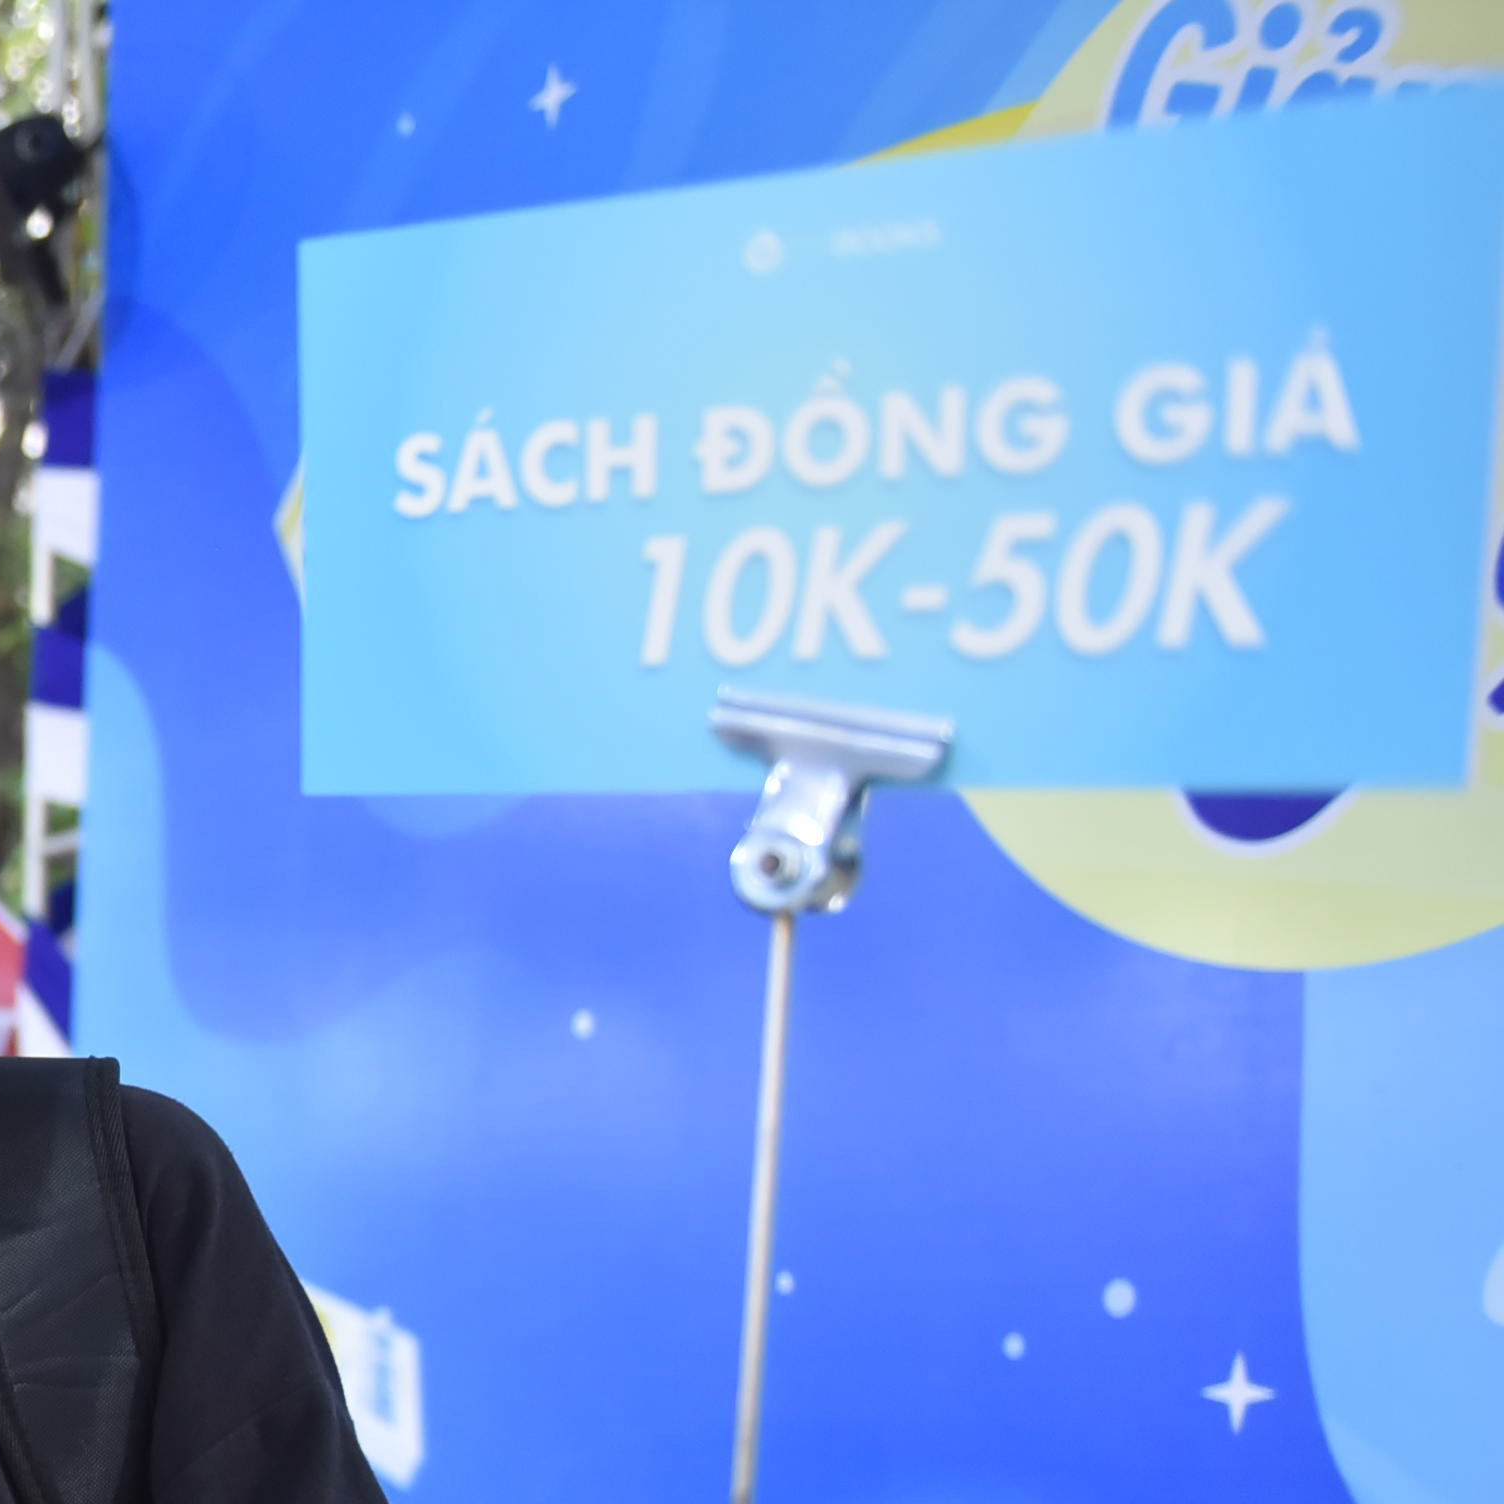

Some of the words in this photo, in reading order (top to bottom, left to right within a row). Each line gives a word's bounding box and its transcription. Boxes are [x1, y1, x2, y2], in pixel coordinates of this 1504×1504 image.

[392, 410, 660, 521] SÁCH
[691, 355, 1072, 491] ĐỒNG
[1112, 320, 1361, 464] GIÁ
[637, 495, 1294, 668] 10K-50K
